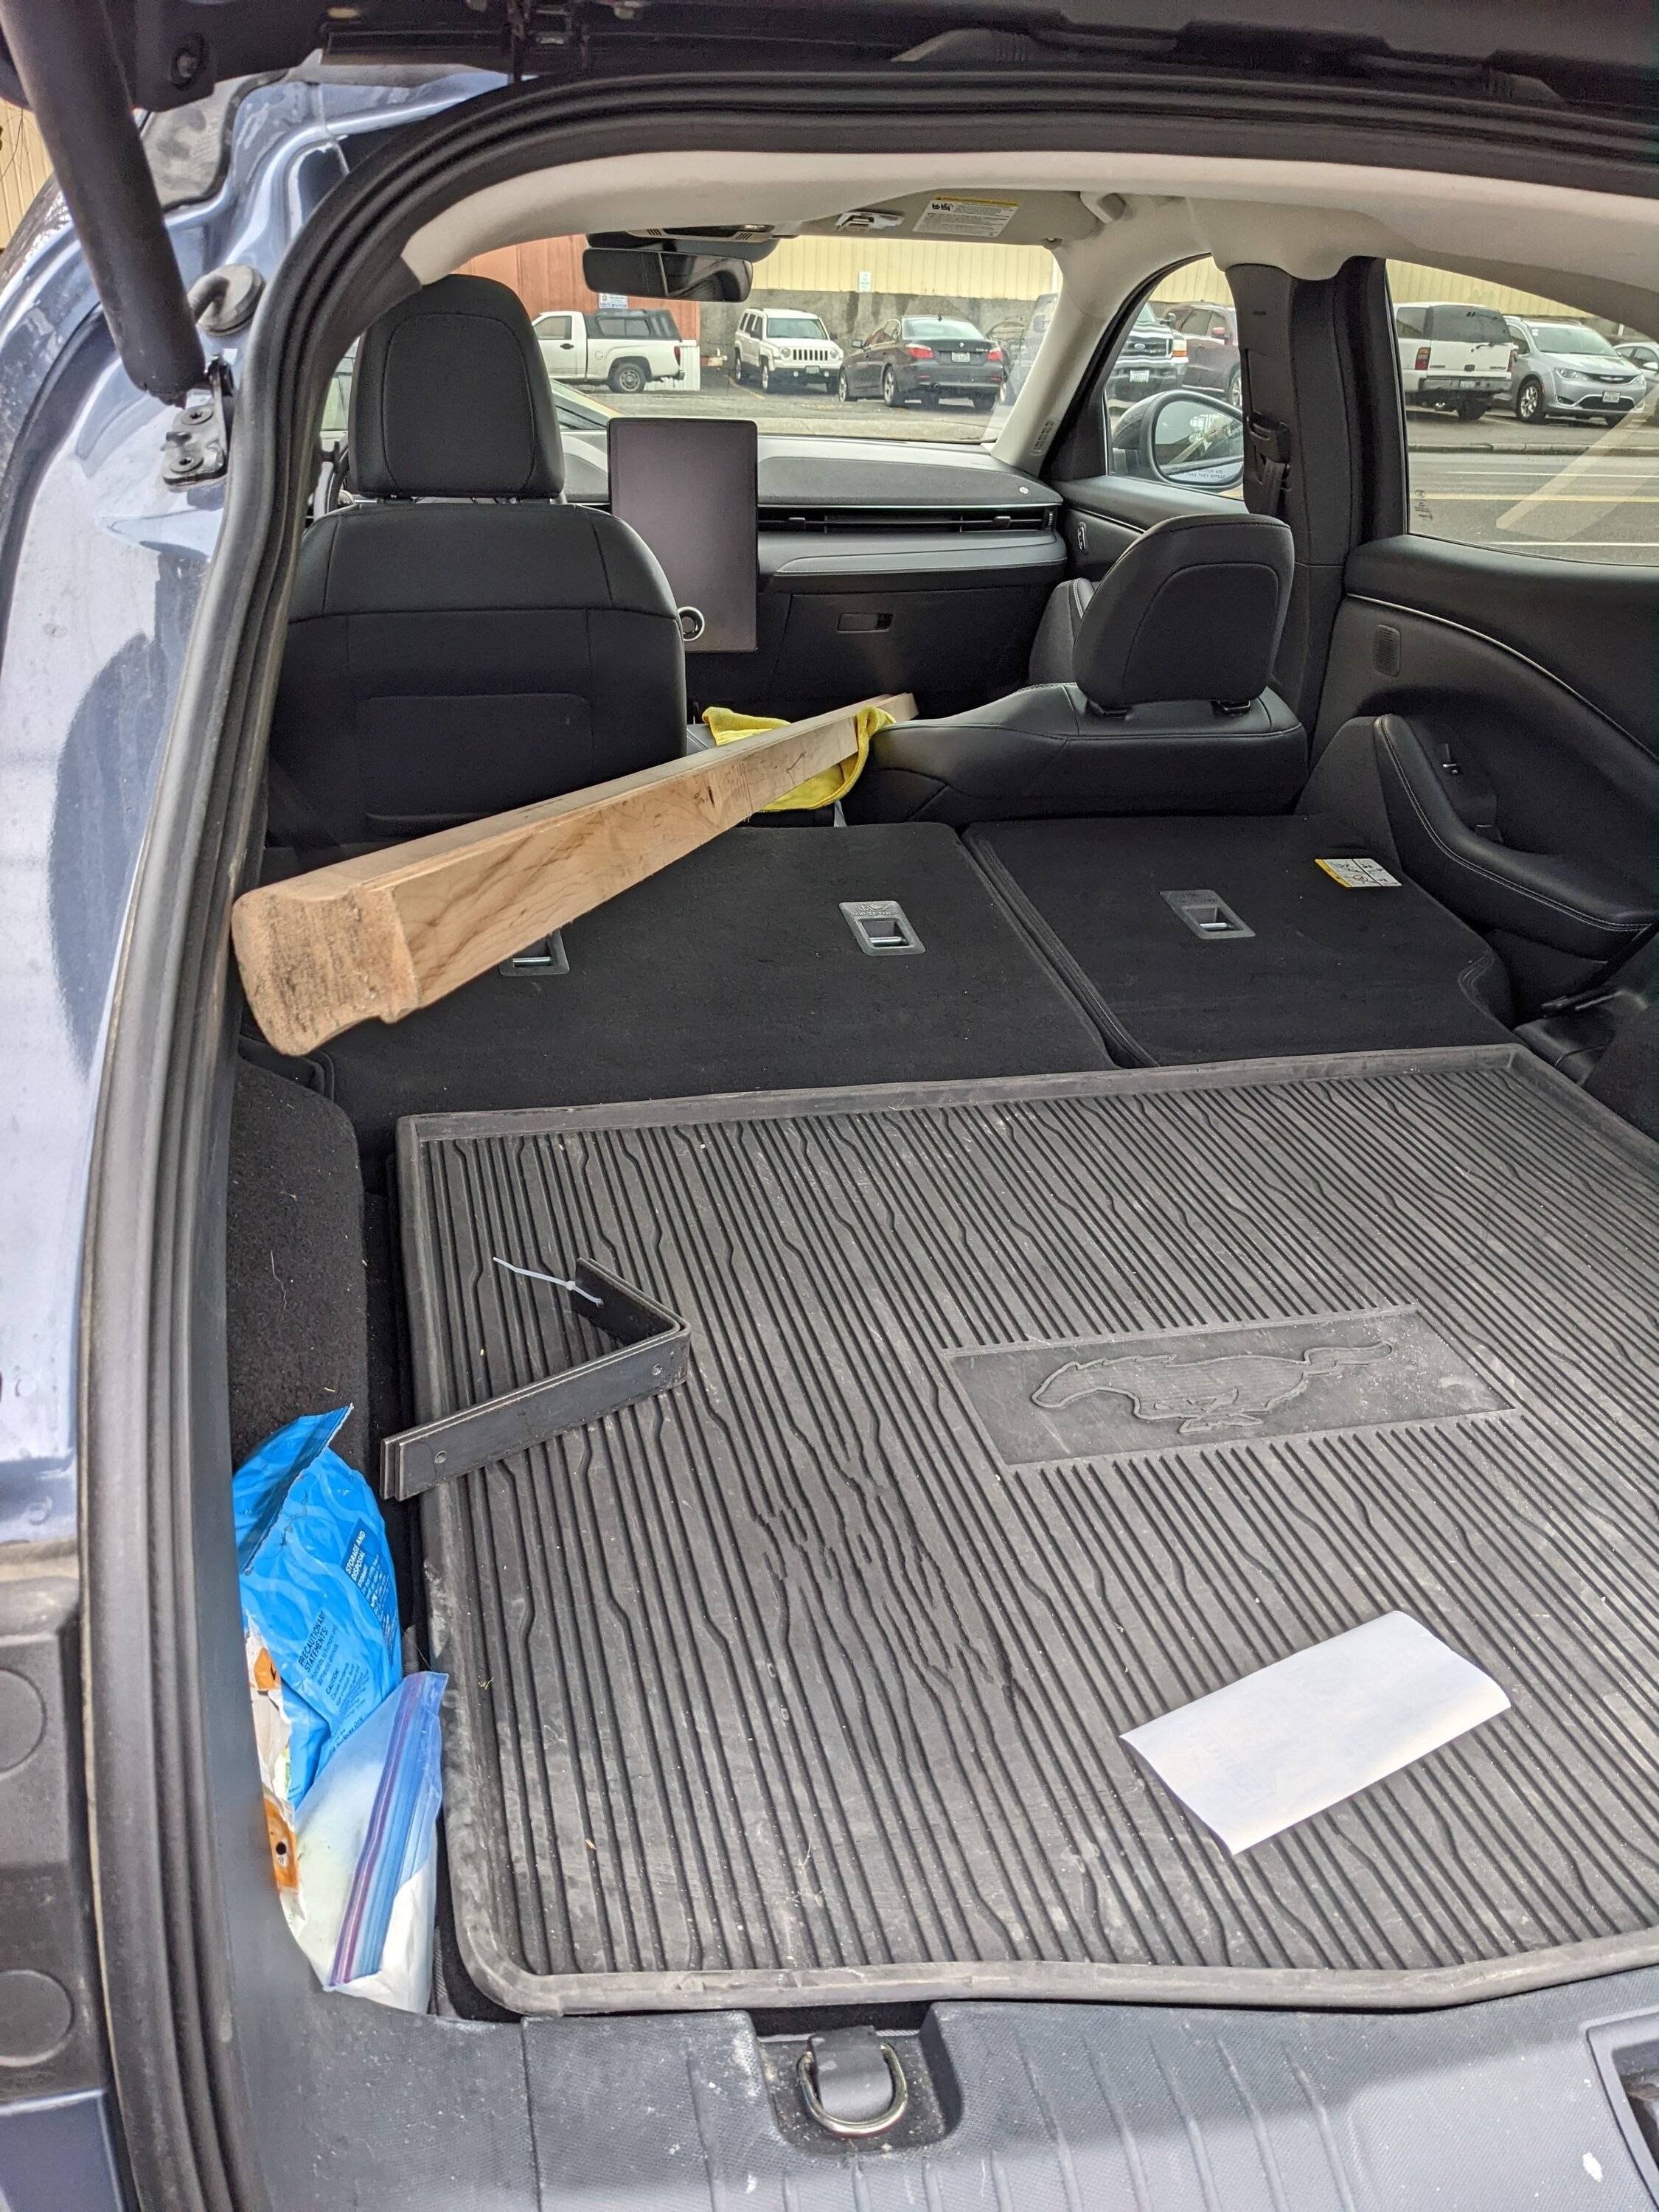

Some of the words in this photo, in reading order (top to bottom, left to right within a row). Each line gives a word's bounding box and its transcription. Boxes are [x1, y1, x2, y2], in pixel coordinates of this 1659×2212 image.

[345, 1543, 360, 1574] STORAGE
[356, 1530, 366, 1546] AND
[351, 1550, 365, 1581] DISPOSAL
[299, 1610, 325, 1666] PRECAUTIONARY
[305, 1627, 329, 1673] STATEMENTS:
